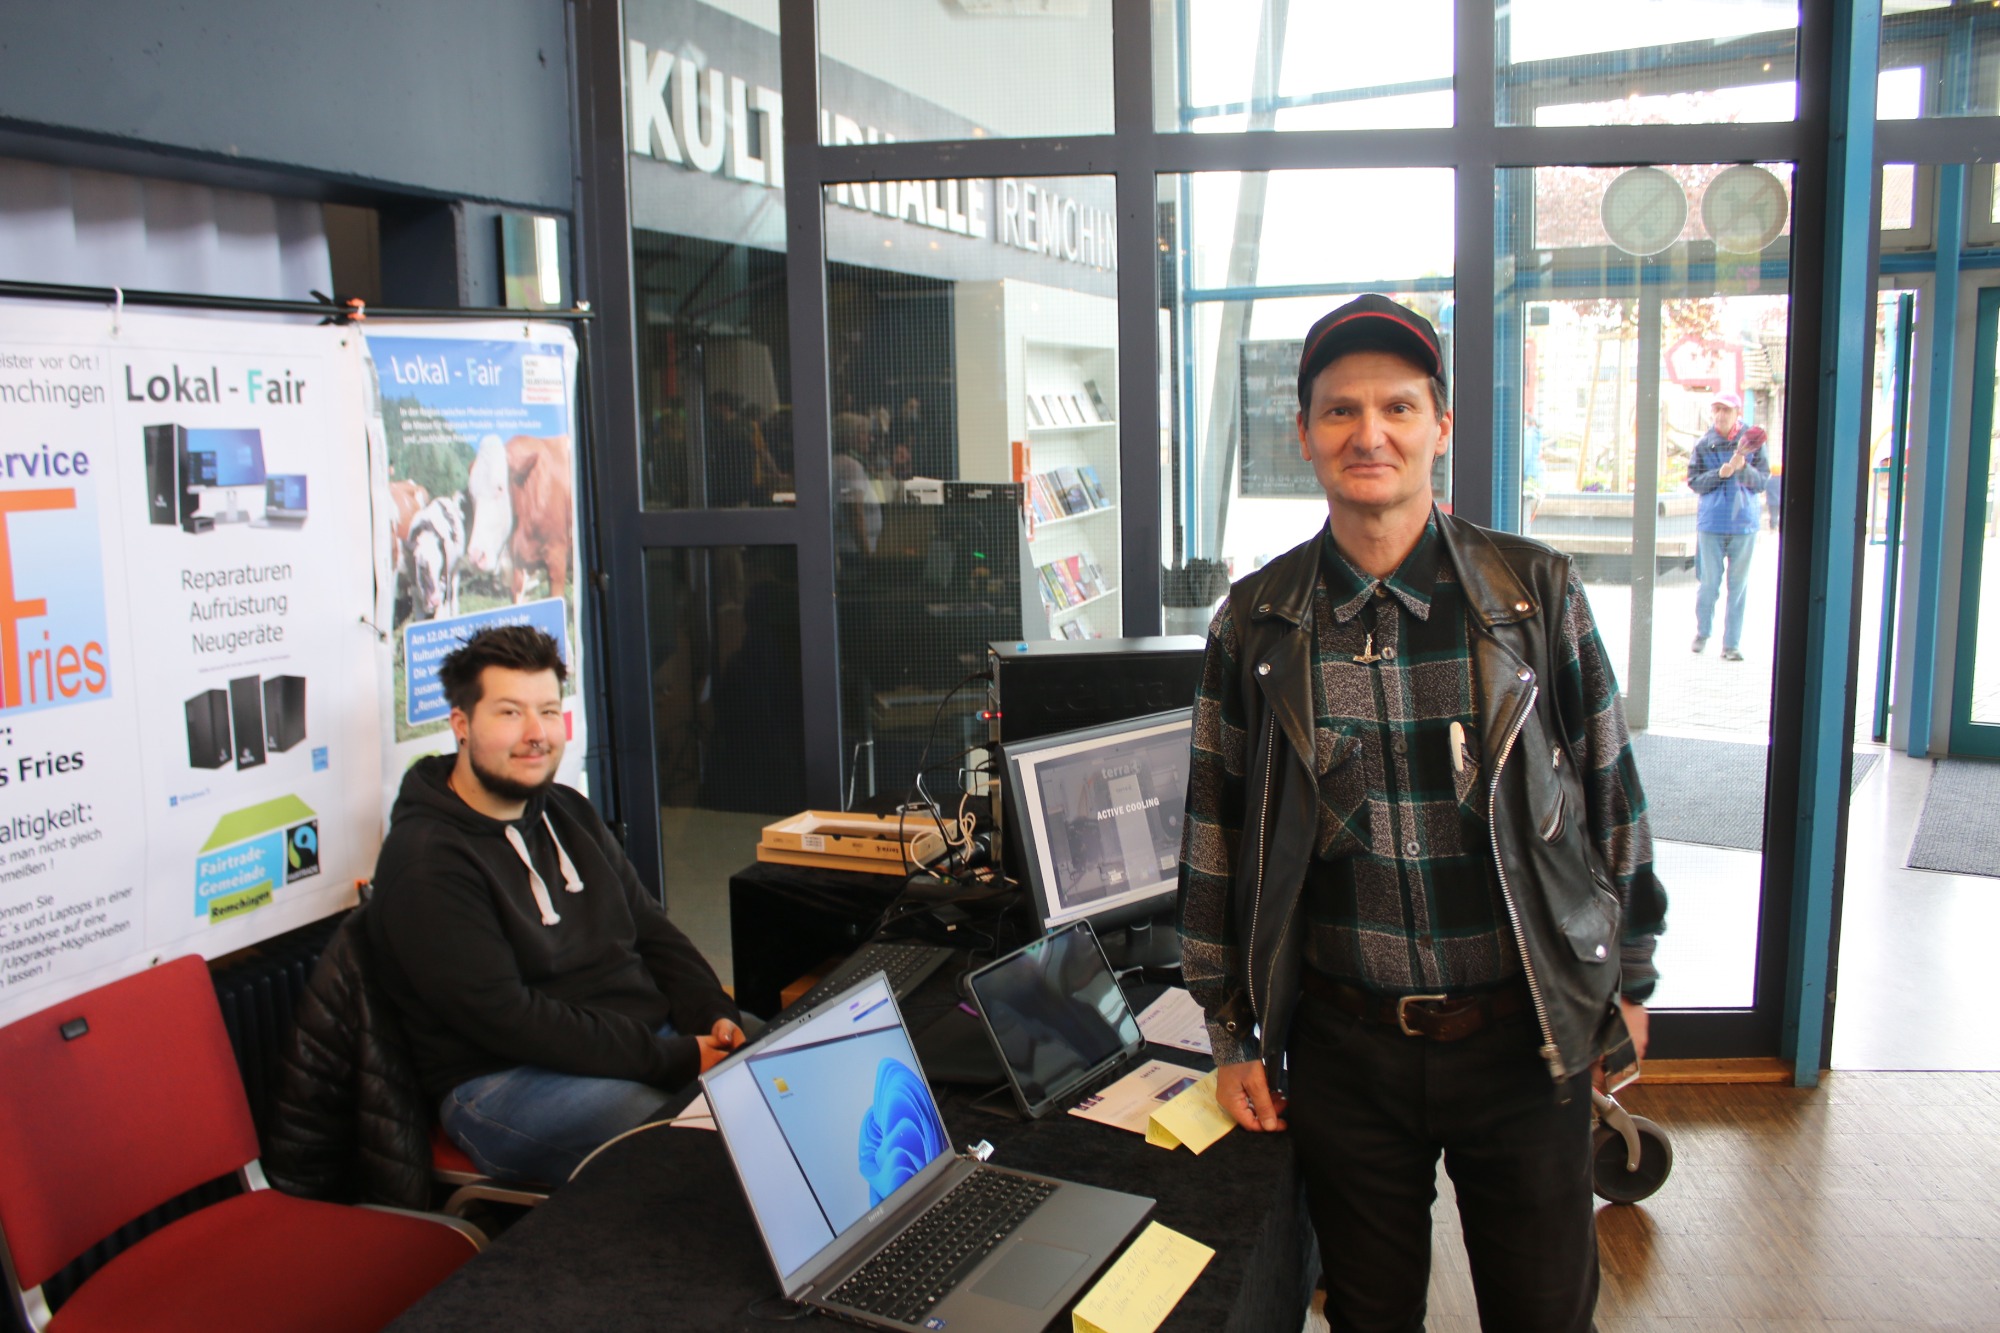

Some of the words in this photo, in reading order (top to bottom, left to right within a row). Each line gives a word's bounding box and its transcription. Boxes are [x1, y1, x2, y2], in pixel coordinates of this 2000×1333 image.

[0, 353, 33, 369] ister
[39, 356, 63, 369] vor
[69, 354, 92, 371] Ort
[390, 354, 449, 385] Lokal
[466, 356, 503, 387] Fair
[125, 364, 221, 404] Lokal
[247, 368, 307, 405] Fair
[0, 444, 90, 478] rvice
[181, 561, 293, 593] Reparaturen
[189, 593, 288, 622] Aufrüstung
[192, 623, 284, 655] Neugeräte
[18, 751, 84, 782] Fries
[1101, 764, 1131, 780] terra
[1097, 805, 1124, 821] ACTIVE
[1125, 796, 1160, 813] COOLING
[9, 847, 36, 863] man
[39, 837, 66, 855] nicht
[70, 828, 103, 850] gleich
[199, 847, 267, 878] Fairtrade-
[198, 866, 266, 897] Gemeinde
[24, 912, 46, 931] und
[49, 901, 93, 922] Laptops
[96, 896, 106, 908] in
[109, 886, 132, 904] einer
[36, 895, 55, 909] Sie
[210, 890, 270, 919] Remchingen
[63, 917, 81, 936] auf
[84, 912, 107, 928] eine
[7, 964, 43, 986] lassen
